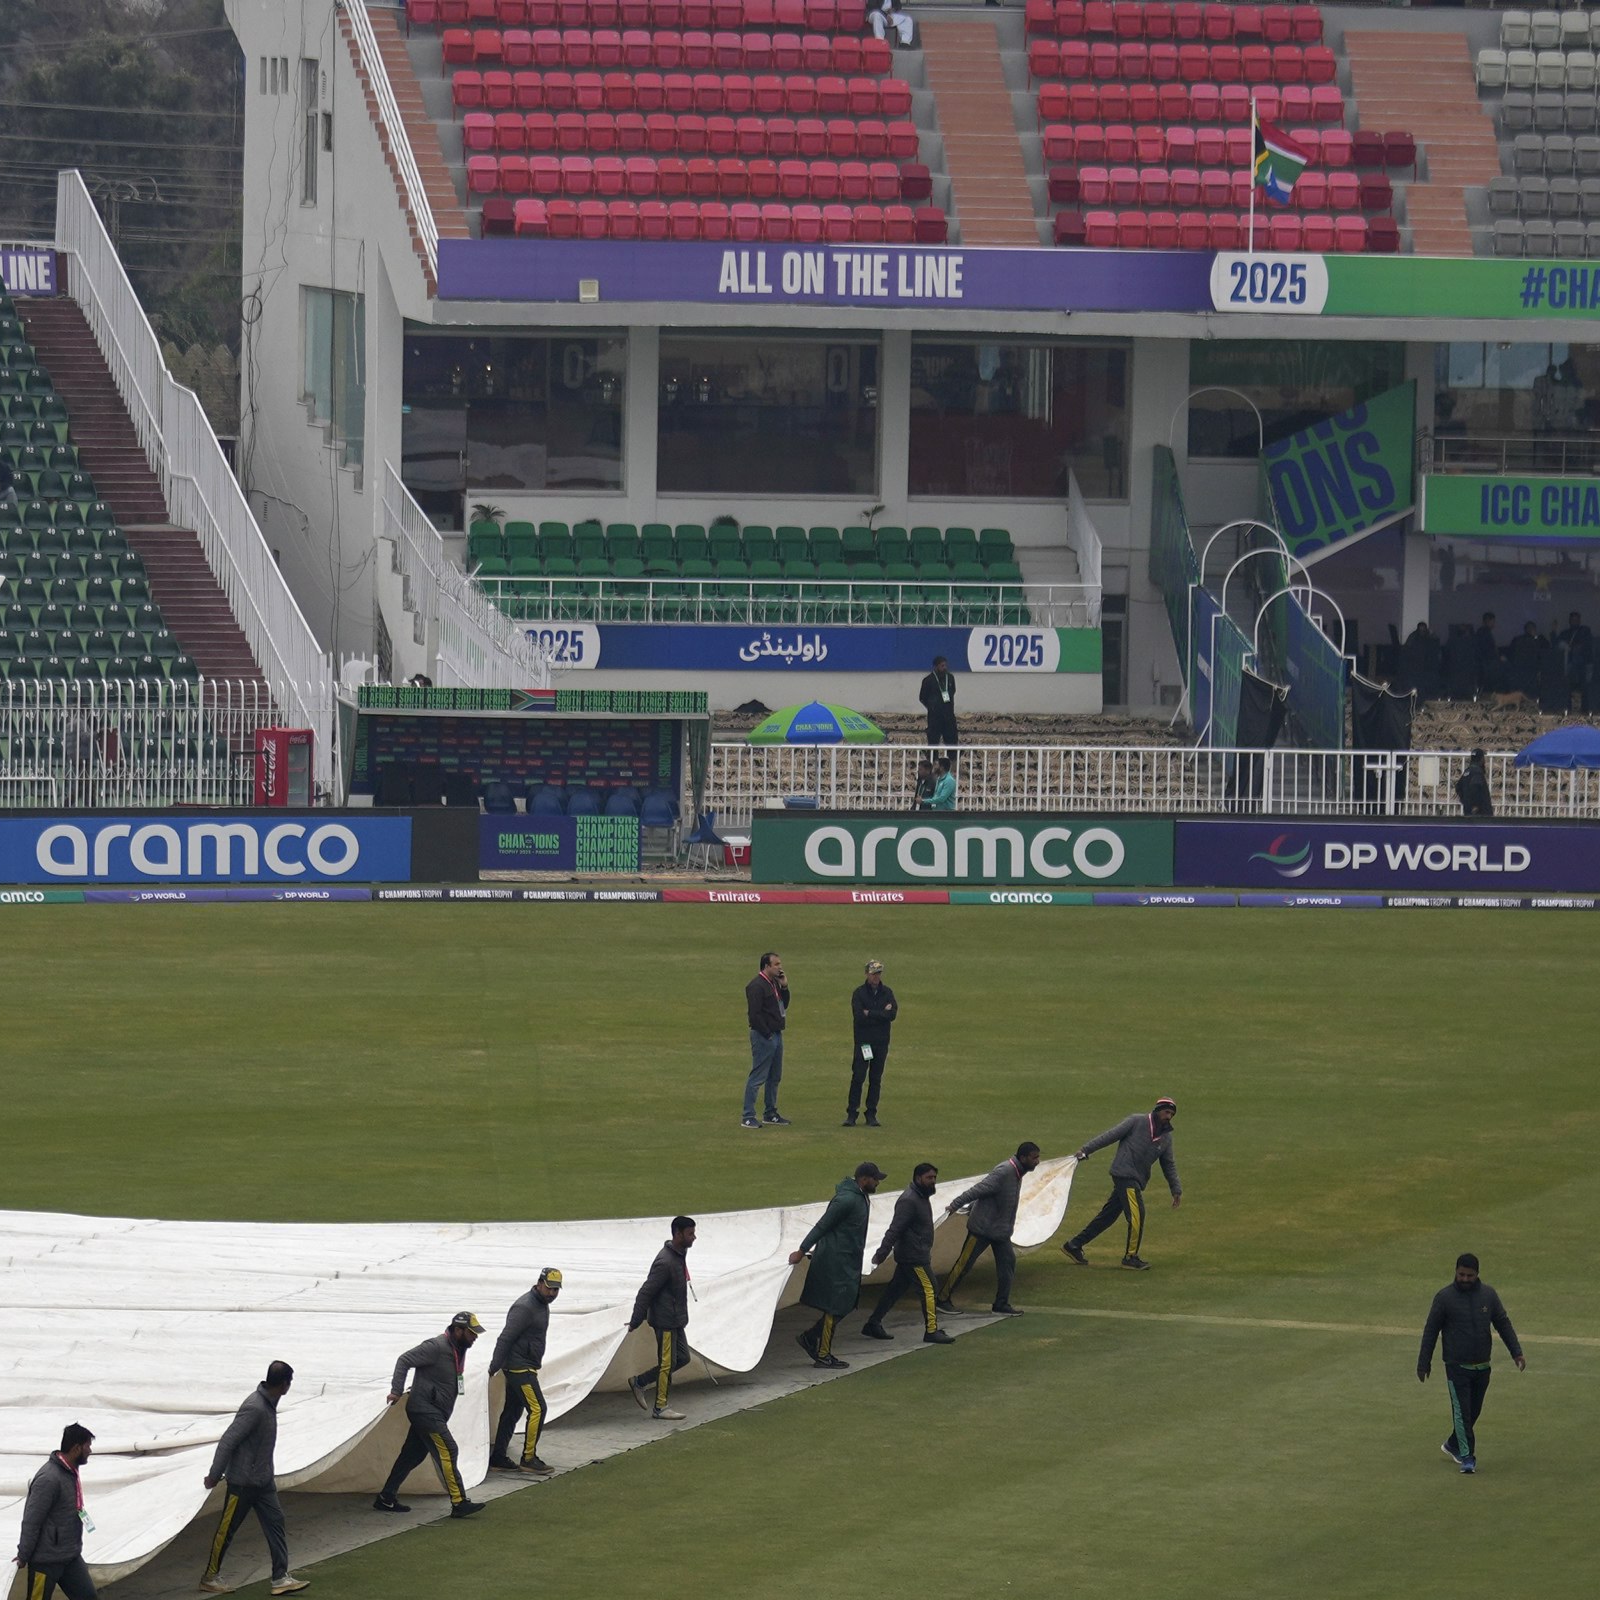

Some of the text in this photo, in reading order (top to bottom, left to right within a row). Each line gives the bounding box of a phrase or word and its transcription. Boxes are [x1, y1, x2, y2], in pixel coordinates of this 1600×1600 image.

[719, 251, 964, 299] ALL ON THE LINE
[1230, 261, 1307, 304] 2025
[1481, 484, 1531, 526] ICC
[739, 632, 828, 664] راولپنڈی
[983, 634, 1044, 667] 2025
[370, 693, 397, 704] AFRICA
[400, 693, 424, 705] SOUTH
[426, 694, 453, 705] AFRICA
[456, 694, 480, 705] SOUTH
[484, 694, 510, 705] AFRICA
[576, 824, 639, 837] CHAMPIONS
[36, 824, 360, 876] aramco
[576, 838, 639, 852] CHAMPIONS
[804, 826, 1125, 878] aramco
[576, 853, 639, 866] CHAMPIONS
[1324, 843, 1531, 872] DP WORLD
[156, 892, 186, 900] WORLD
[709, 891, 760, 903] Emirates
[852, 891, 904, 903] Emirates
[990, 892, 1052, 903] aramco
[1164, 896, 1194, 904] WORLD
